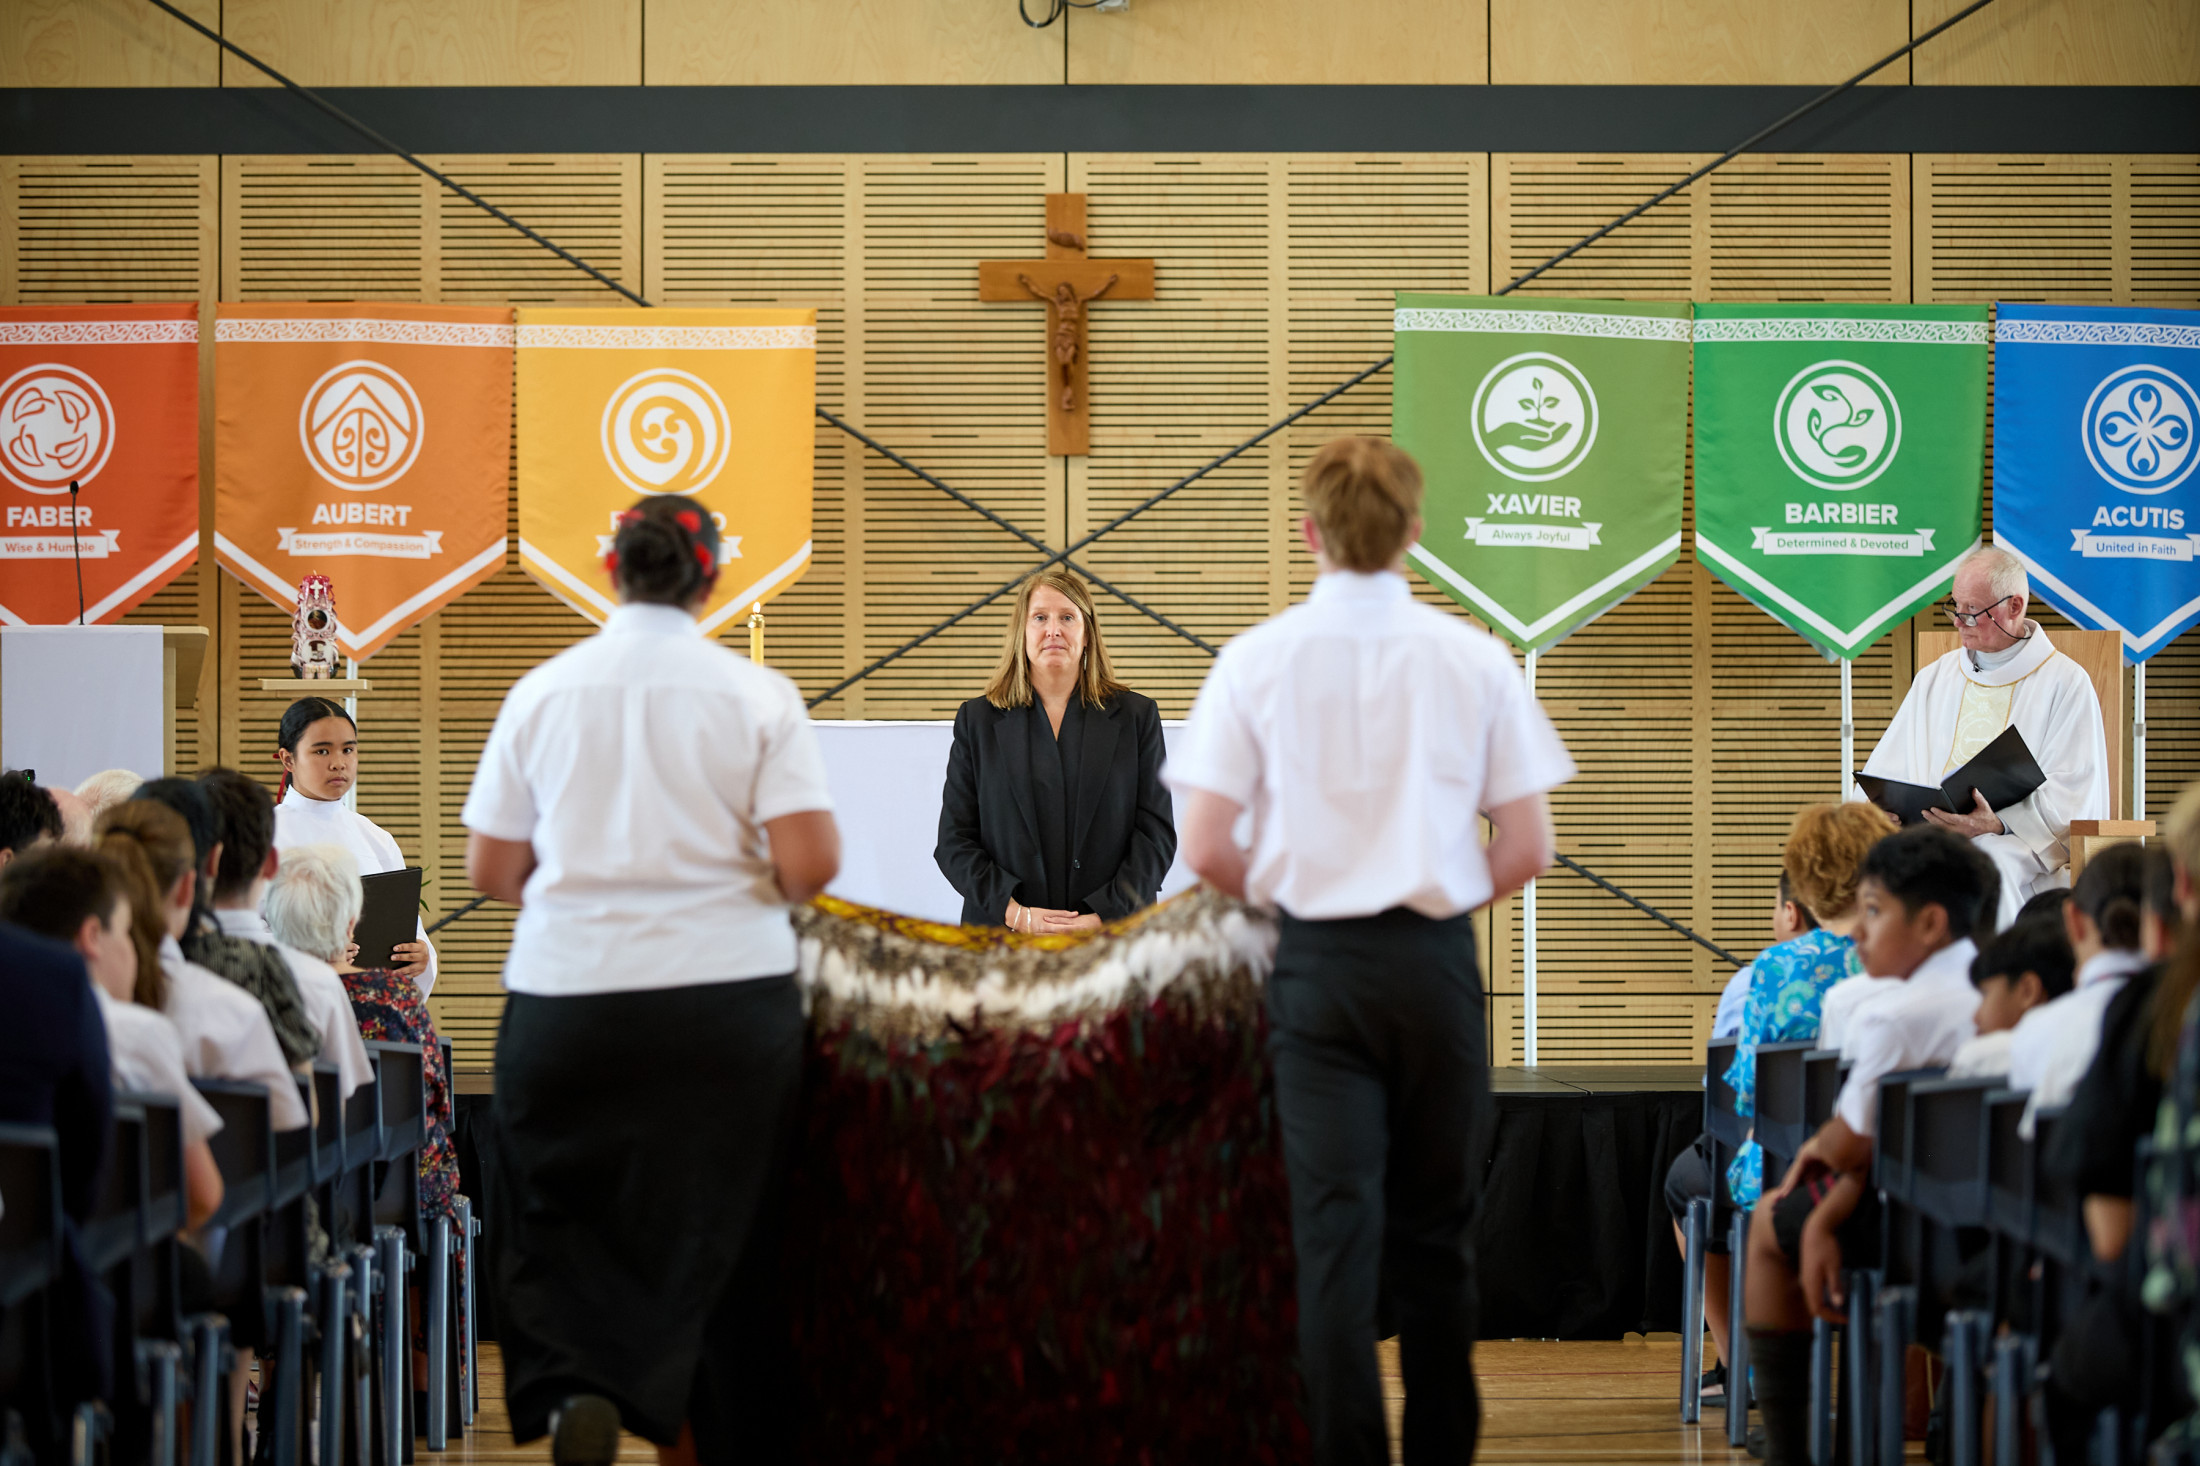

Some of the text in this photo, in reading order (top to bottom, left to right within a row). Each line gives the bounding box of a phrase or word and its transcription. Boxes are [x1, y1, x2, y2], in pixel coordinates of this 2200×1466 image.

[311, 502, 413, 526] AUBERT
[1486, 493, 1582, 518] XAVIER
[1785, 502, 1899, 525] BARBIER
[7, 506, 93, 528] FABER
[2092, 506, 2185, 530] ACUTIS
[295, 538, 343, 551] Strength
[354, 537, 425, 553] Compassion
[1492, 529, 1571, 543] Always Joyful
[1777, 537, 1909, 550] Determined & Devoted
[5, 542, 95, 553] Wise & Humble
[2096, 542, 2177, 555] United in Faith
